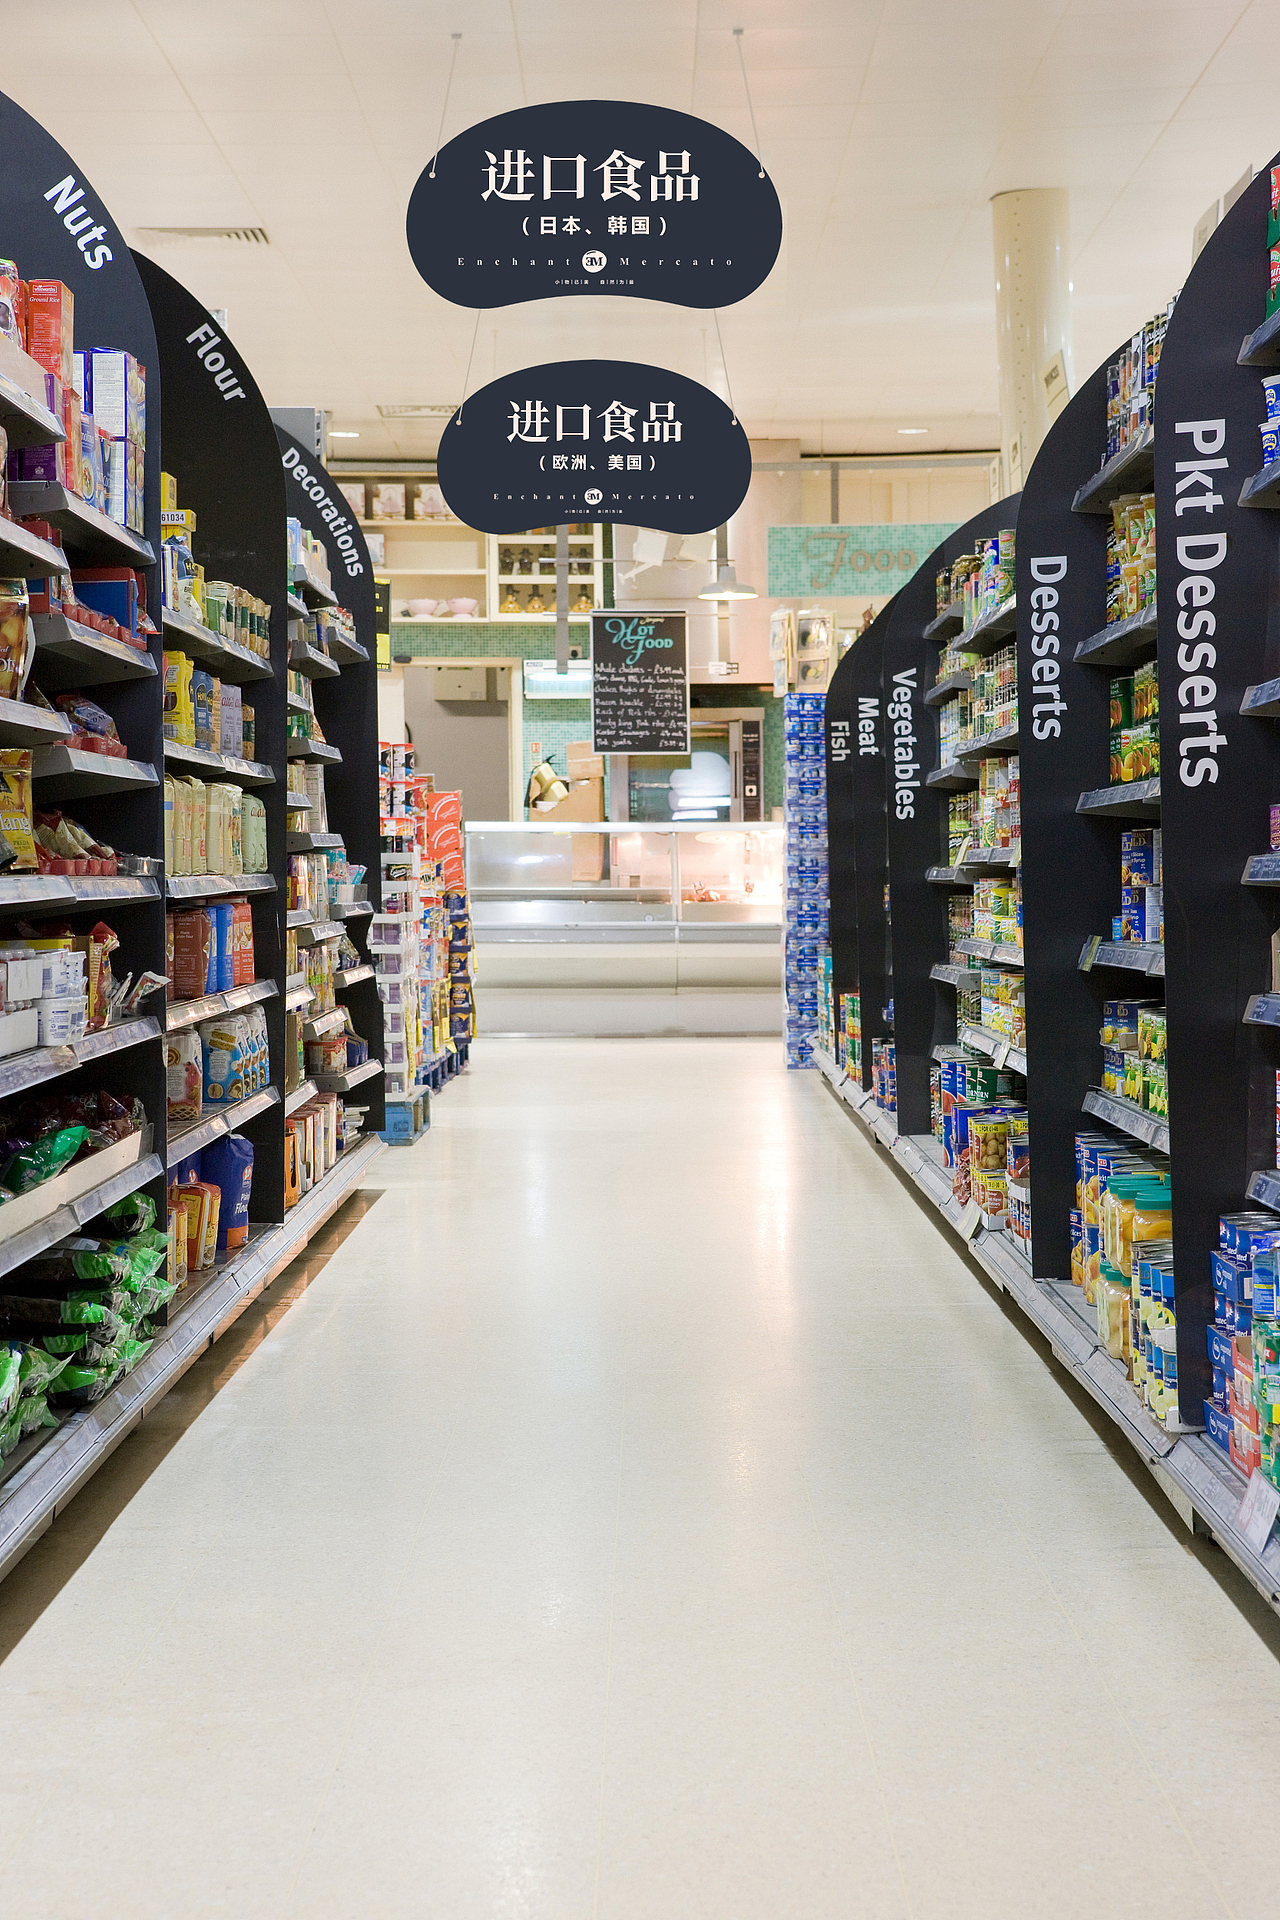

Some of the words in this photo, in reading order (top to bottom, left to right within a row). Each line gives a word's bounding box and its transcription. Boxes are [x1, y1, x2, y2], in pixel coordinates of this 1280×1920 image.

[480, 149, 701, 202] 进口食品
[43, 175, 114, 270] Nuts
[457, 257, 571, 266] Enchant
[620, 257, 732, 266] Mercato
[186, 322, 246, 402] Flour
[506, 399, 683, 443] 进口食品
[1174, 418, 1230, 517] Pkt
[161, 513, 185, 522] 61034
[282, 448, 364, 578] Decorations
[1030, 555, 1068, 741] Desserts
[1176, 532, 1228, 788] Desserts
[830, 721, 851, 762] Fish
[857, 697, 880, 756] Meat
[887, 667, 921, 820] Vegetables
